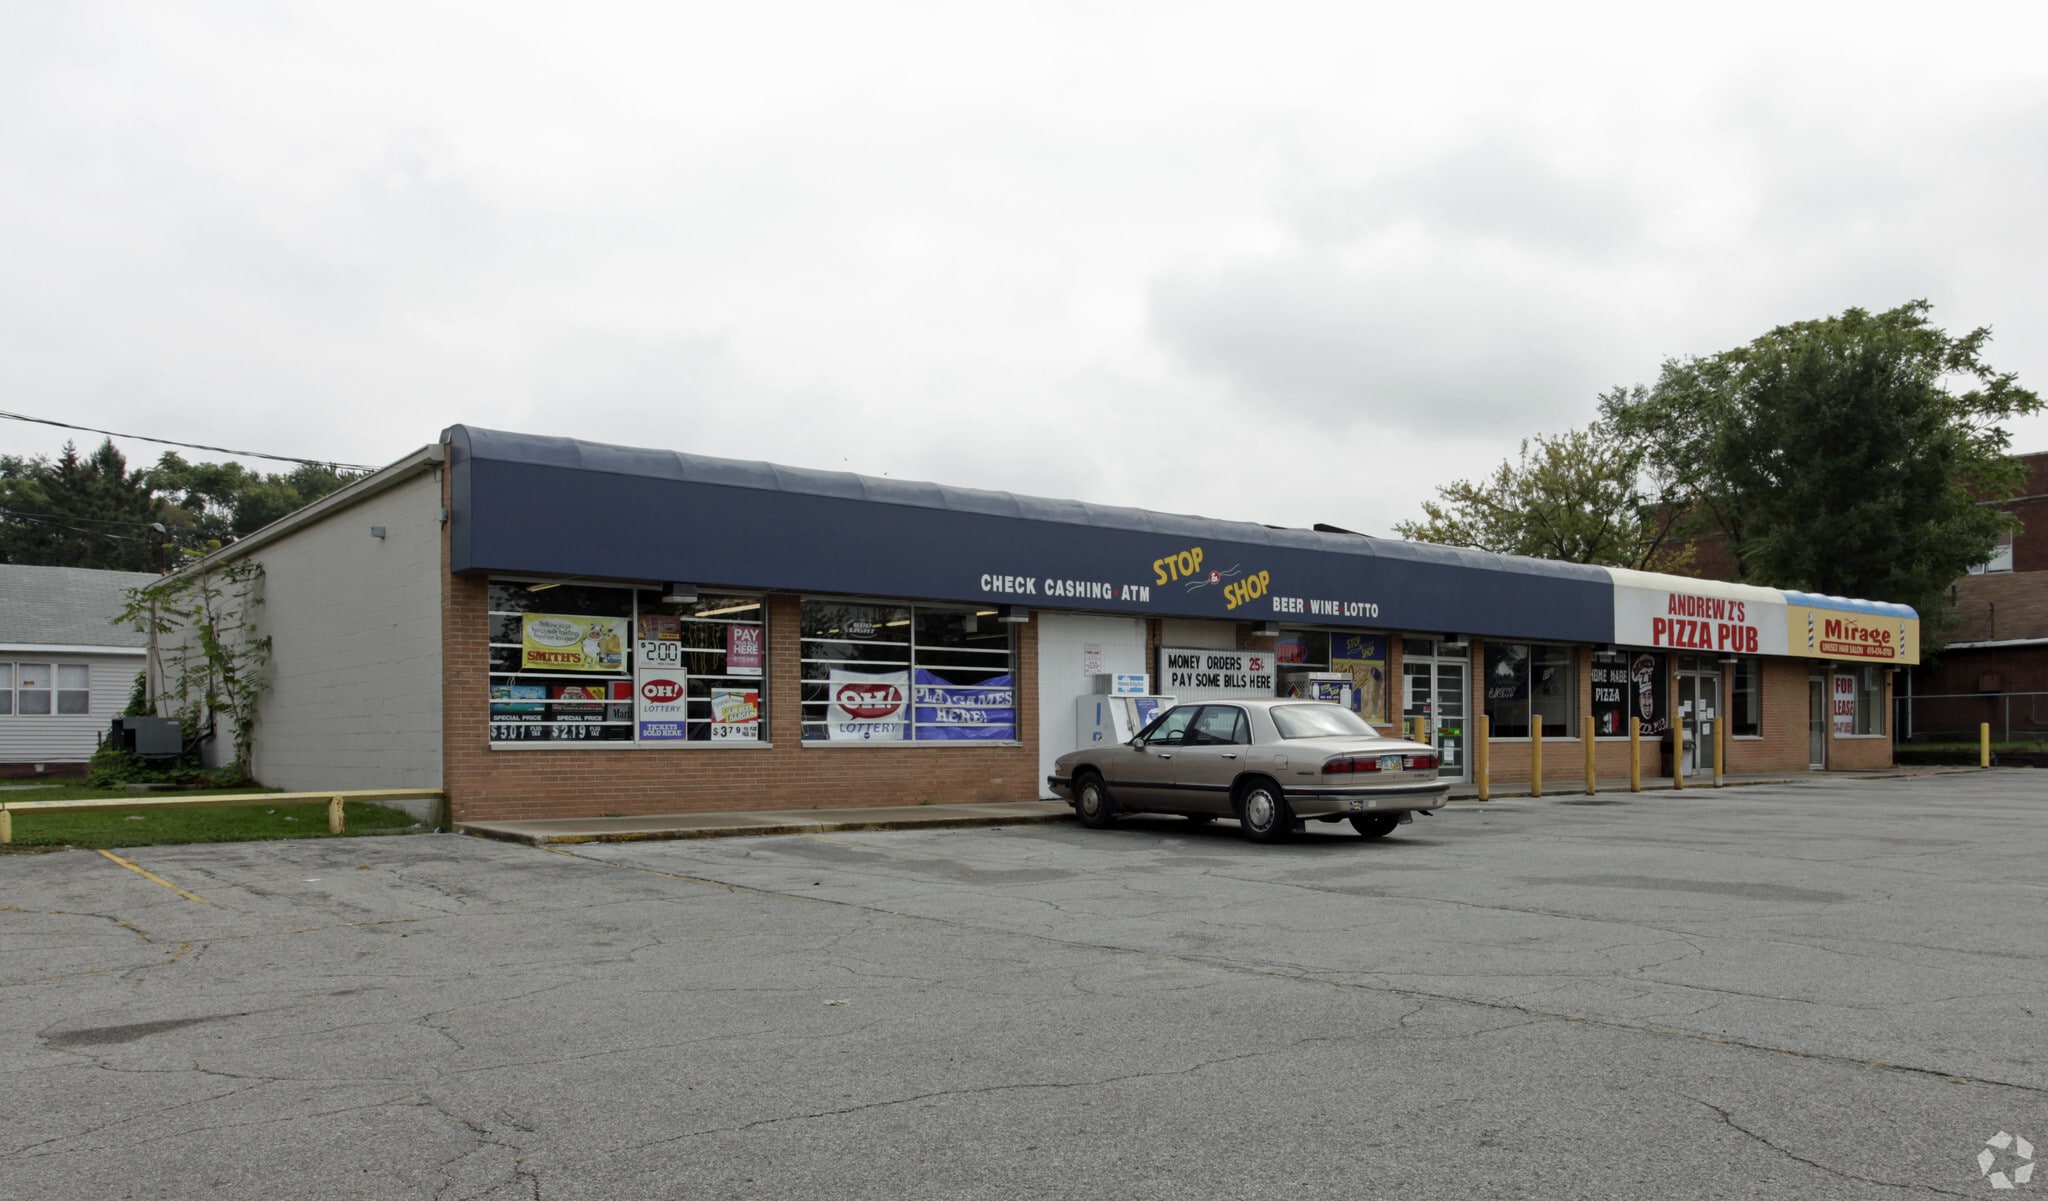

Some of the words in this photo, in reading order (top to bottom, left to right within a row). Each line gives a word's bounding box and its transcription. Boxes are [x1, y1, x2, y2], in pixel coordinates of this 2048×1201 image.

[1153, 546, 1204, 586] STOP
[1210, 571, 1219, 584] &
[1223, 570, 1270, 610] SHOP
[981, 574, 1036, 595] CHECK
[1044, 578, 1112, 600] CASHING
[1121, 584, 1150, 603] ATM
[1272, 596, 1304, 614] BEER
[1310, 598, 1340, 616] WINE
[1344, 600, 1379, 618] LOTTO
[1668, 593, 1726, 620] ANDREW
[1728, 600, 1745, 623] Z'S
[733, 628, 759, 642] PAY
[1652, 616, 1713, 649] PIZZA
[1717, 622, 1759, 653] PUB
[1825, 618, 1891, 647] Mirage
[733, 645, 759, 655] HERE
[1346, 636, 1361, 650] STOP
[1361, 645, 1375, 659] SHOP
[527, 650, 581, 663] SMITH'S
[1168, 654, 1200, 670] MONEY
[1207, 655, 1242, 671] ORDERS
[1172, 673, 1192, 687] PAY
[1196, 673, 1221, 688] SOME
[1224, 674, 1247, 688] BILLS
[1249, 675, 1271, 689] HERE
[1609, 669, 1628, 683] MADE
[643, 683, 680, 698] OH!
[1835, 677, 1853, 694] FOR
[840, 686, 896, 710] OH!
[953, 691, 1013, 706] GAMES
[1595, 687, 1620, 702] PIZZA
[613, 706, 632, 719] Marl
[644, 705, 681, 713] LOTTERY
[1834, 699, 1854, 716] LEASE
[936, 708, 988, 724] HERE!
[839, 722, 898, 734] LOTTERY
